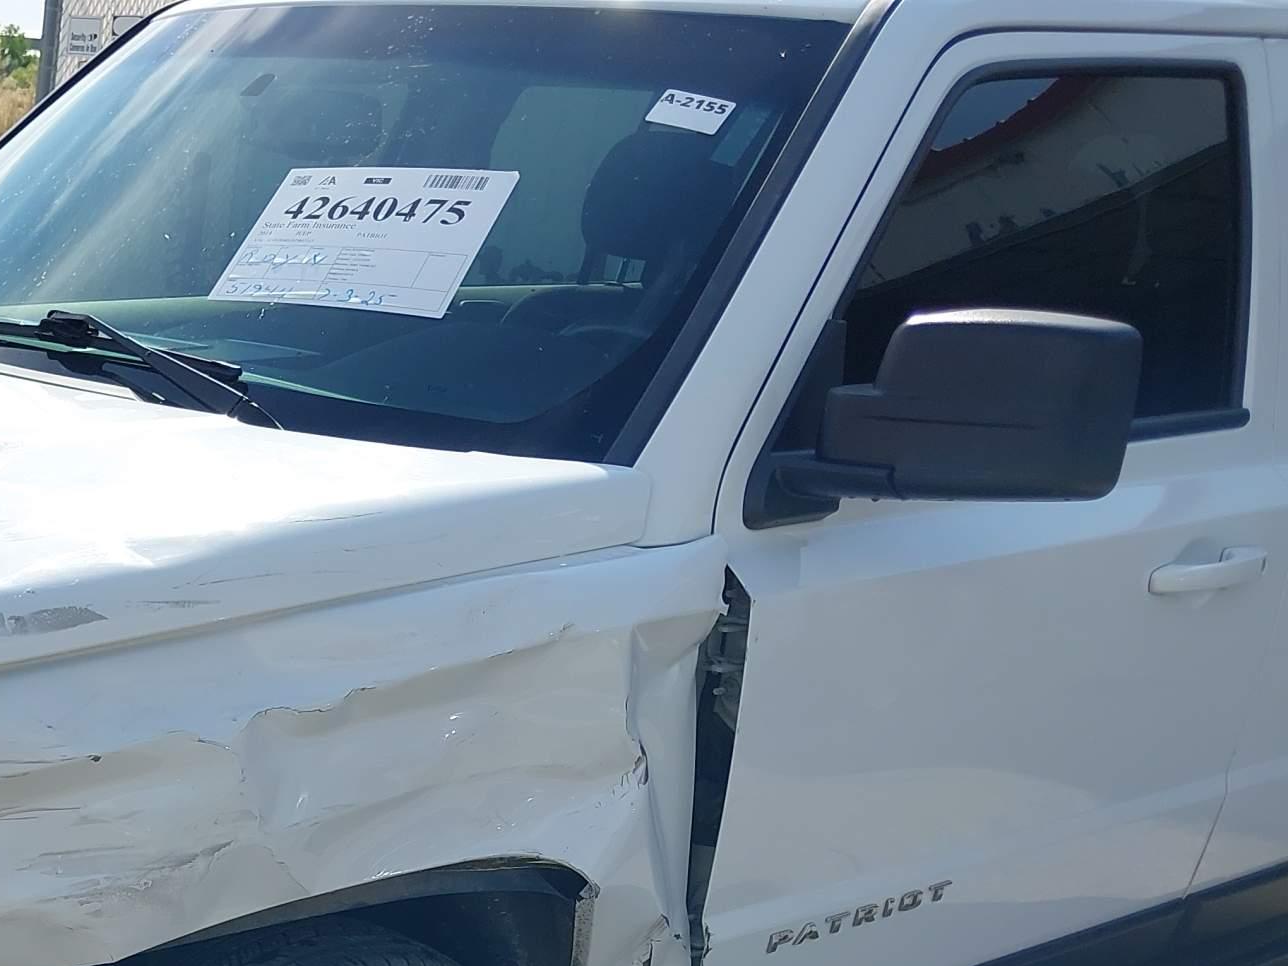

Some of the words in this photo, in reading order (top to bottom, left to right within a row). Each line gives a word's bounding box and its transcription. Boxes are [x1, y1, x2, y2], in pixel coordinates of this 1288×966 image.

[660, 93, 729, 115] A-2155
[284, 196, 472, 225] 42640475
[262, 221, 286, 229] State
[286, 221, 310, 229] Farm
[312, 222, 357, 230] Insurance
[765, 879, 953, 954] PATRIOT
